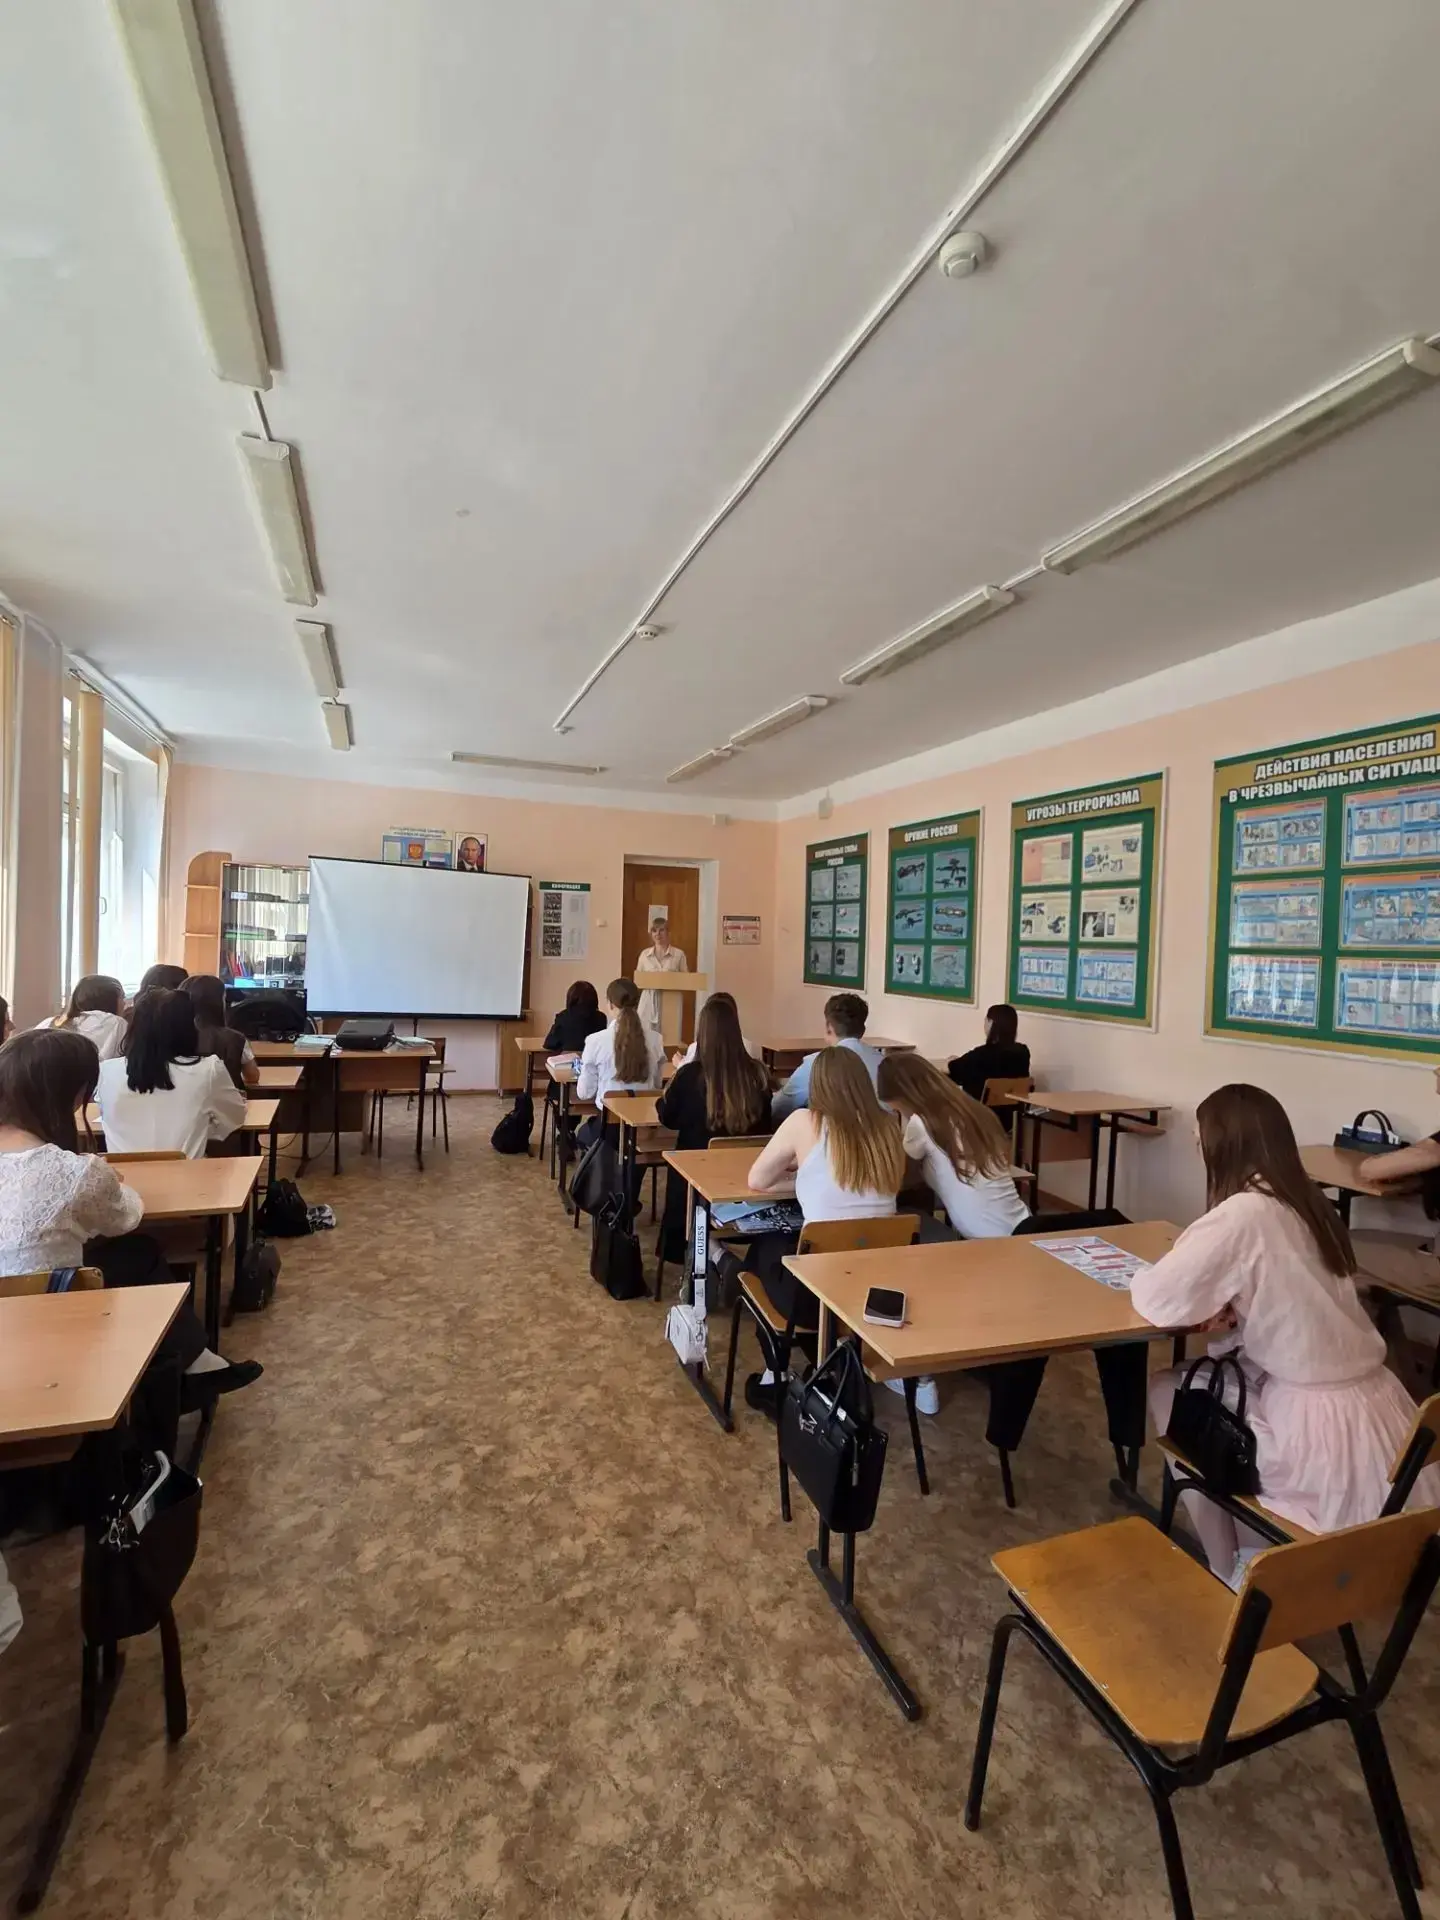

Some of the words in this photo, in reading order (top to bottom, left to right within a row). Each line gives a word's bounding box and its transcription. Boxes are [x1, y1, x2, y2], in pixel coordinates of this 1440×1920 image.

[1255, 752, 1331, 781] ДЕЙСТВИЯ
[1333, 732, 1434, 764] НАСЕЛЕНИЯ
[1228, 789, 1238, 803] В
[1241, 767, 1365, 801] ЧРЕЗВЫЧАЙНЫХ
[1026, 803, 1066, 821] УГРОЗЫ
[1067, 789, 1140, 814] ТЕРРОРИЗМА
[697, 1225, 705, 1255] GUESS
